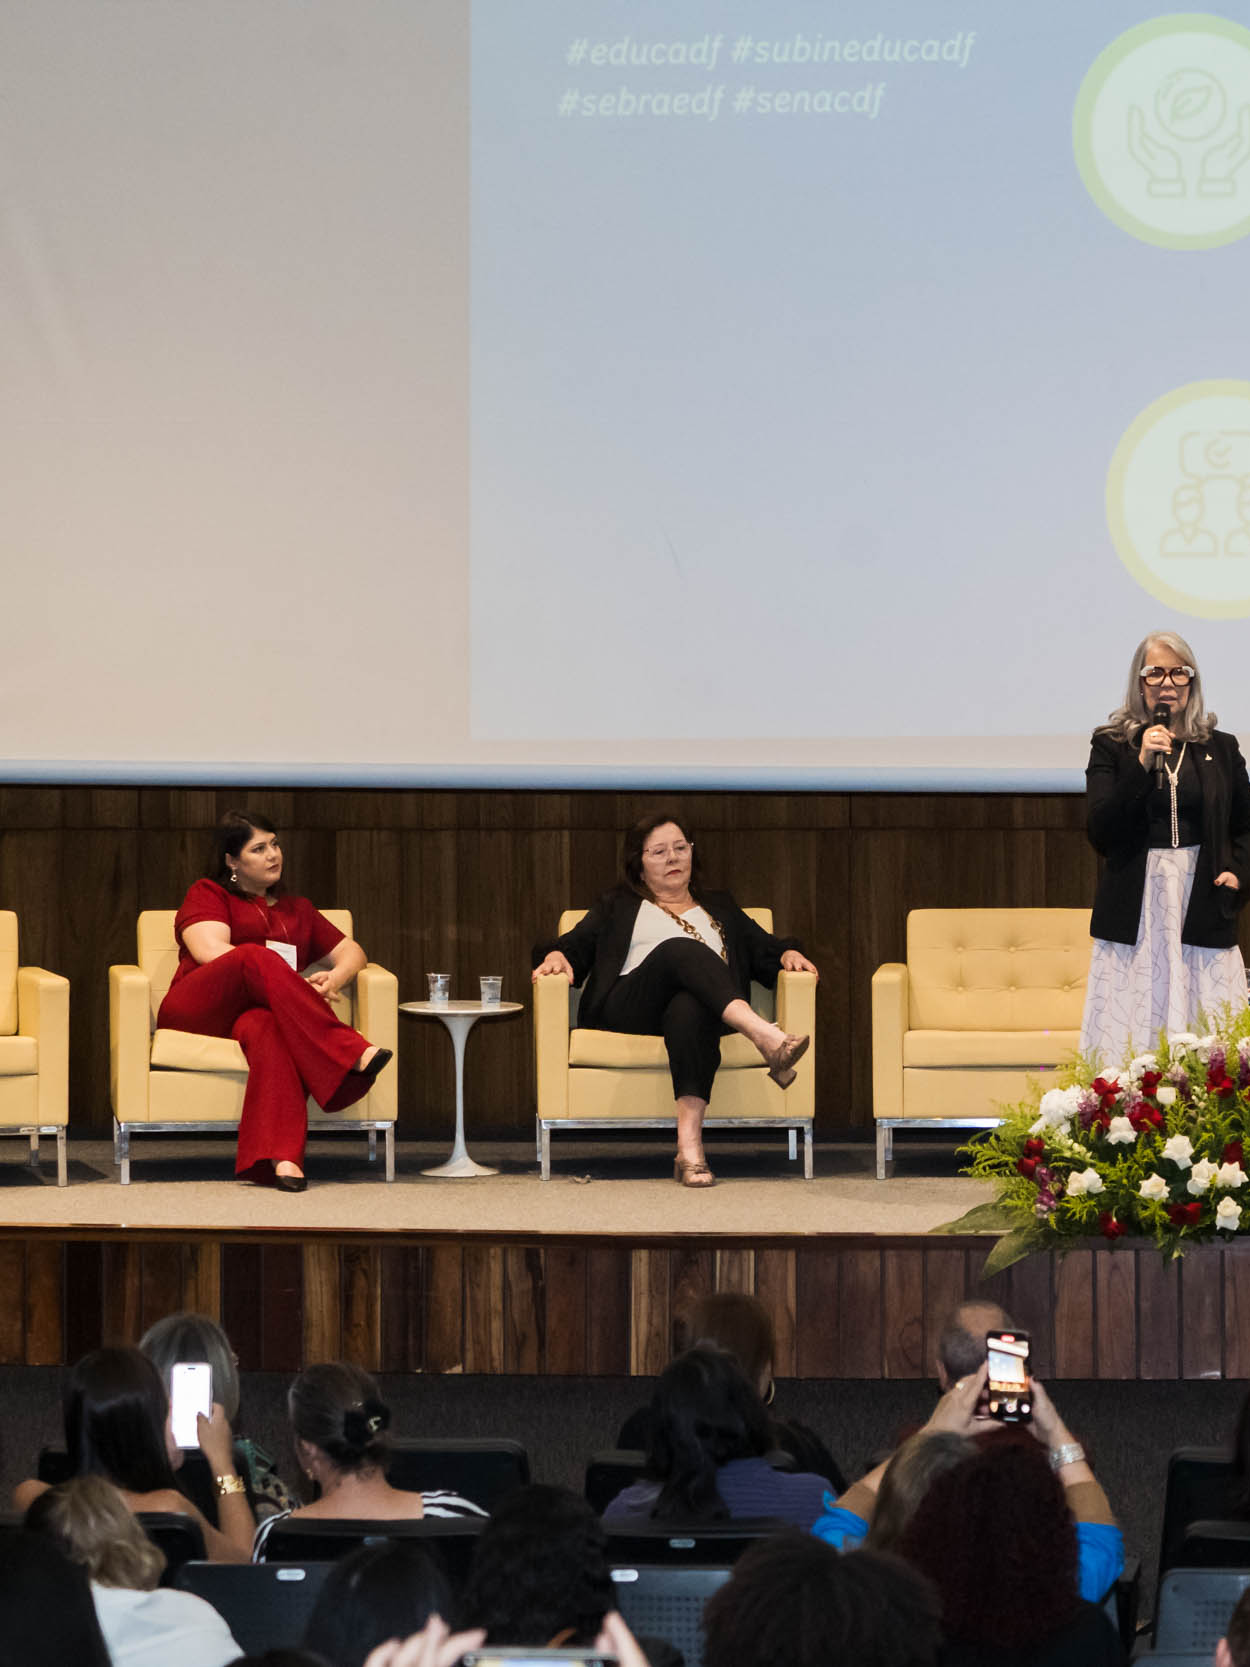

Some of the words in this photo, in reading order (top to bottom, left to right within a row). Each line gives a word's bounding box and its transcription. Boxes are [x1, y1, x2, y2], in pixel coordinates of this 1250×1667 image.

[566, 34, 724, 70] #educadf
[731, 32, 976, 68] #subineducadf
[558, 85, 725, 121] #sebraedf
[733, 82, 886, 118] #senacdf
